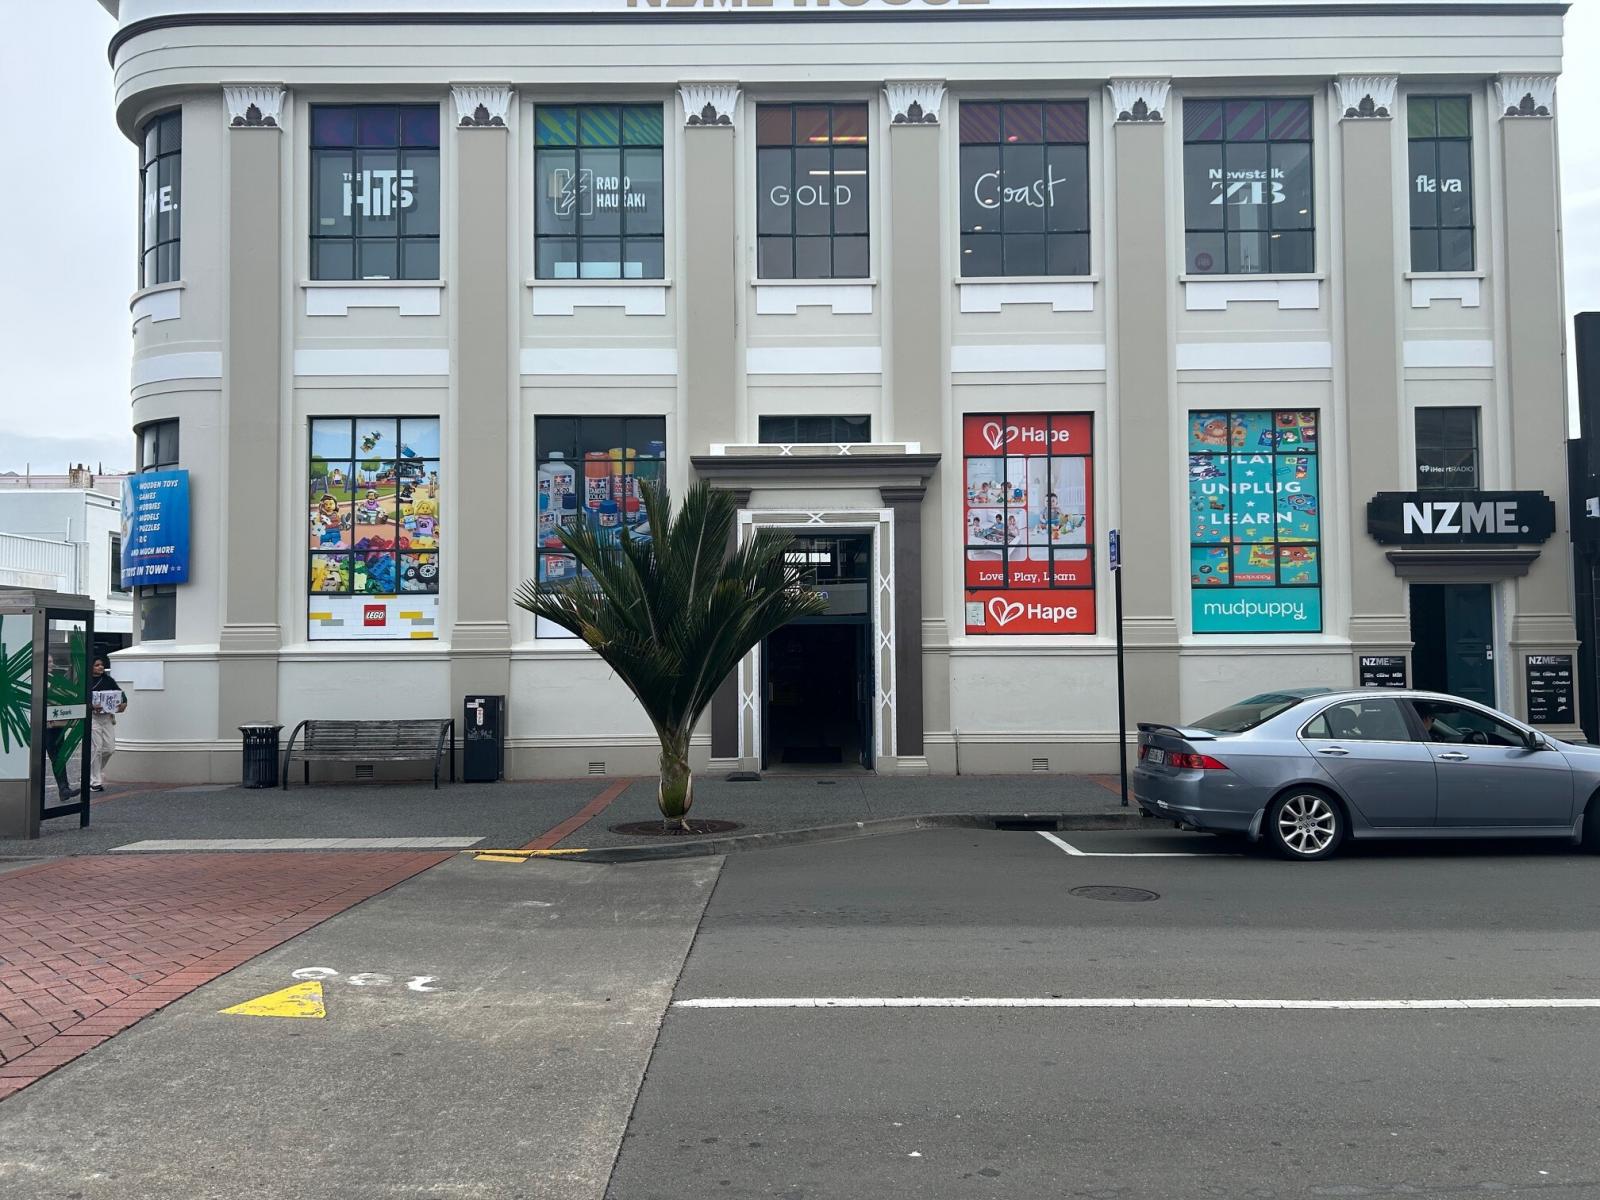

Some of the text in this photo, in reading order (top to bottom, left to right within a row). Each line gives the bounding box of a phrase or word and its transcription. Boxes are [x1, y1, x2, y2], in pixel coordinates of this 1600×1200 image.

[596, 176, 631, 190] RADO
[974, 165, 1066, 208] Coast
[770, 185, 851, 206] GOLD
[1209, 181, 1286, 205] ZB
[1021, 426, 1069, 446] Hape
[163, 479, 178, 488] TOYS
[1201, 481, 1301, 494] UNPLUG
[1211, 511, 1293, 525] LEARN
[1403, 501, 1529, 534] NZME.
[155, 545, 175, 554] MORE
[145, 563, 169, 575] TOWN
[1014, 572, 1041, 583] Play,
[366, 611, 384, 619] LEGO
[1027, 603, 1078, 623] Hape
[1204, 598, 1307, 620] mudpuppy
